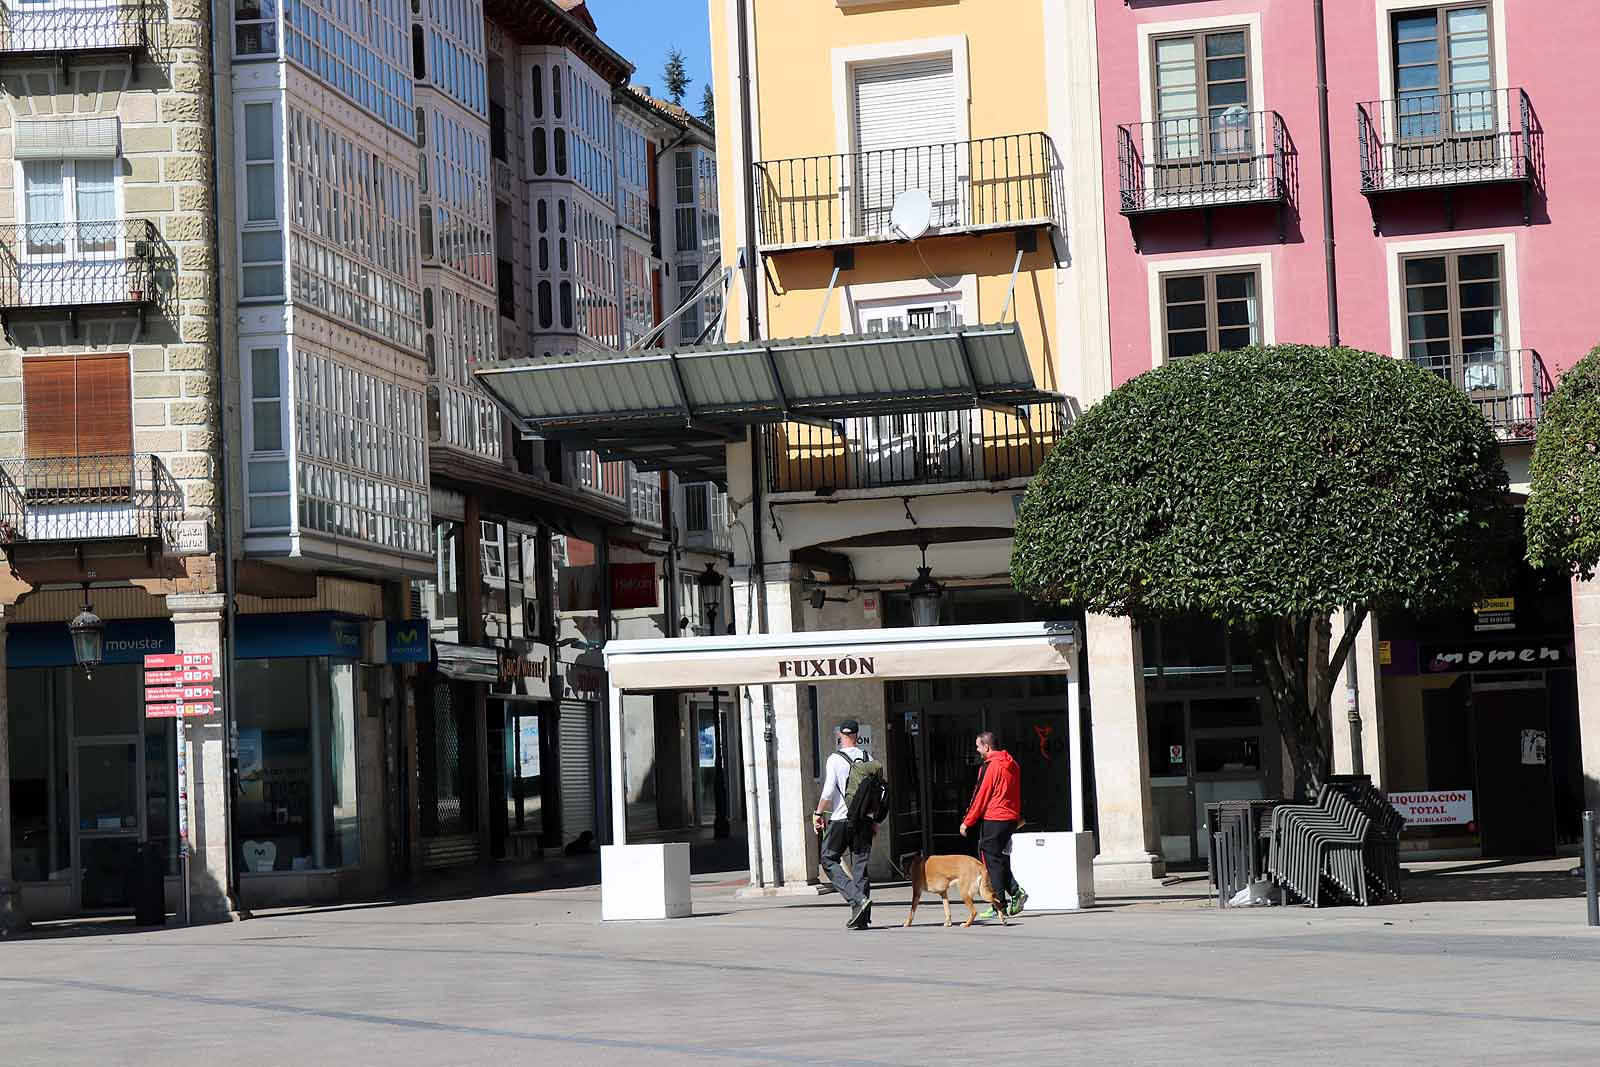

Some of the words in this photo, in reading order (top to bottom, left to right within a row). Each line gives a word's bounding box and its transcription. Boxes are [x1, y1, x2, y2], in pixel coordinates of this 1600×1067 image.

[106, 637, 163, 650] movistar
[778, 654, 875, 677] FUXIÓN
[1390, 792, 1466, 805] LIQUIDACIÓN
[1408, 806, 1447, 814] TOTAL
